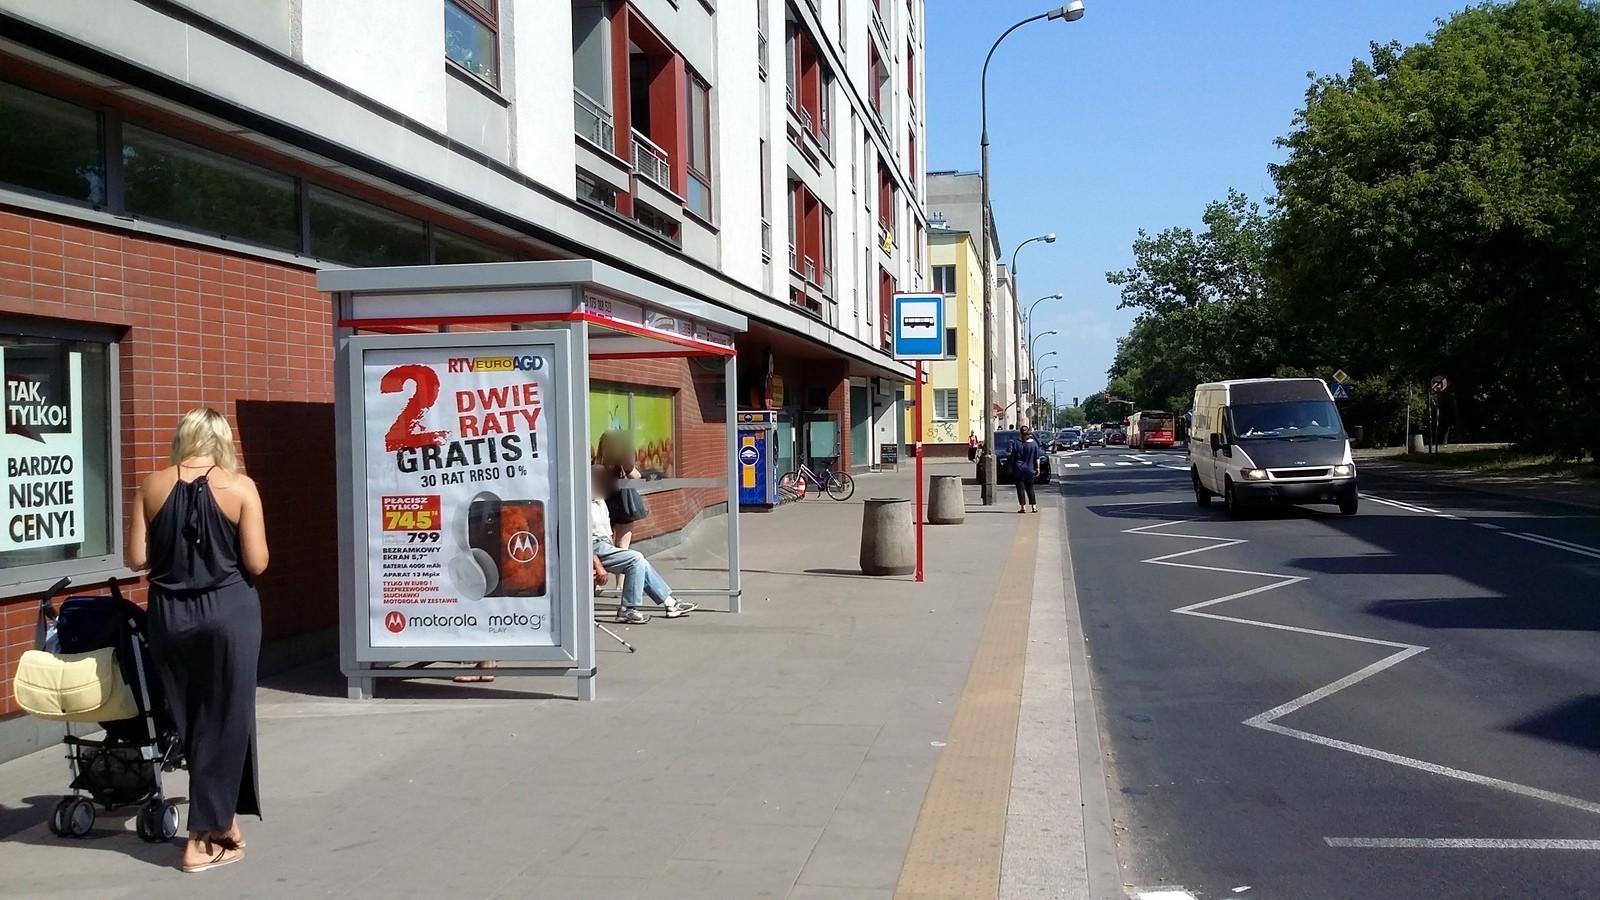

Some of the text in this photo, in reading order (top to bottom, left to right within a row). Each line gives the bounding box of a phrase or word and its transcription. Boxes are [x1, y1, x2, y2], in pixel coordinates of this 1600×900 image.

[447, 356, 543, 373] RTV EURO AGD
[8, 380, 46, 405] TAK,
[456, 383, 540, 413] DWIE
[9, 405, 68, 426] TYLKO!
[381, 364, 450, 452] 2
[458, 408, 542, 438] RATY
[8, 455, 73, 478] BARDZO
[421, 475, 436, 488] 30
[442, 471, 465, 485] RAT
[470, 468, 500, 483] RRSO
[9, 481, 74, 509] NISKIE
[9, 510, 75, 543] CENY!
[386, 511, 432, 529] 745
[407, 532, 440, 543] 799
[409, 613, 477, 626] motorola
